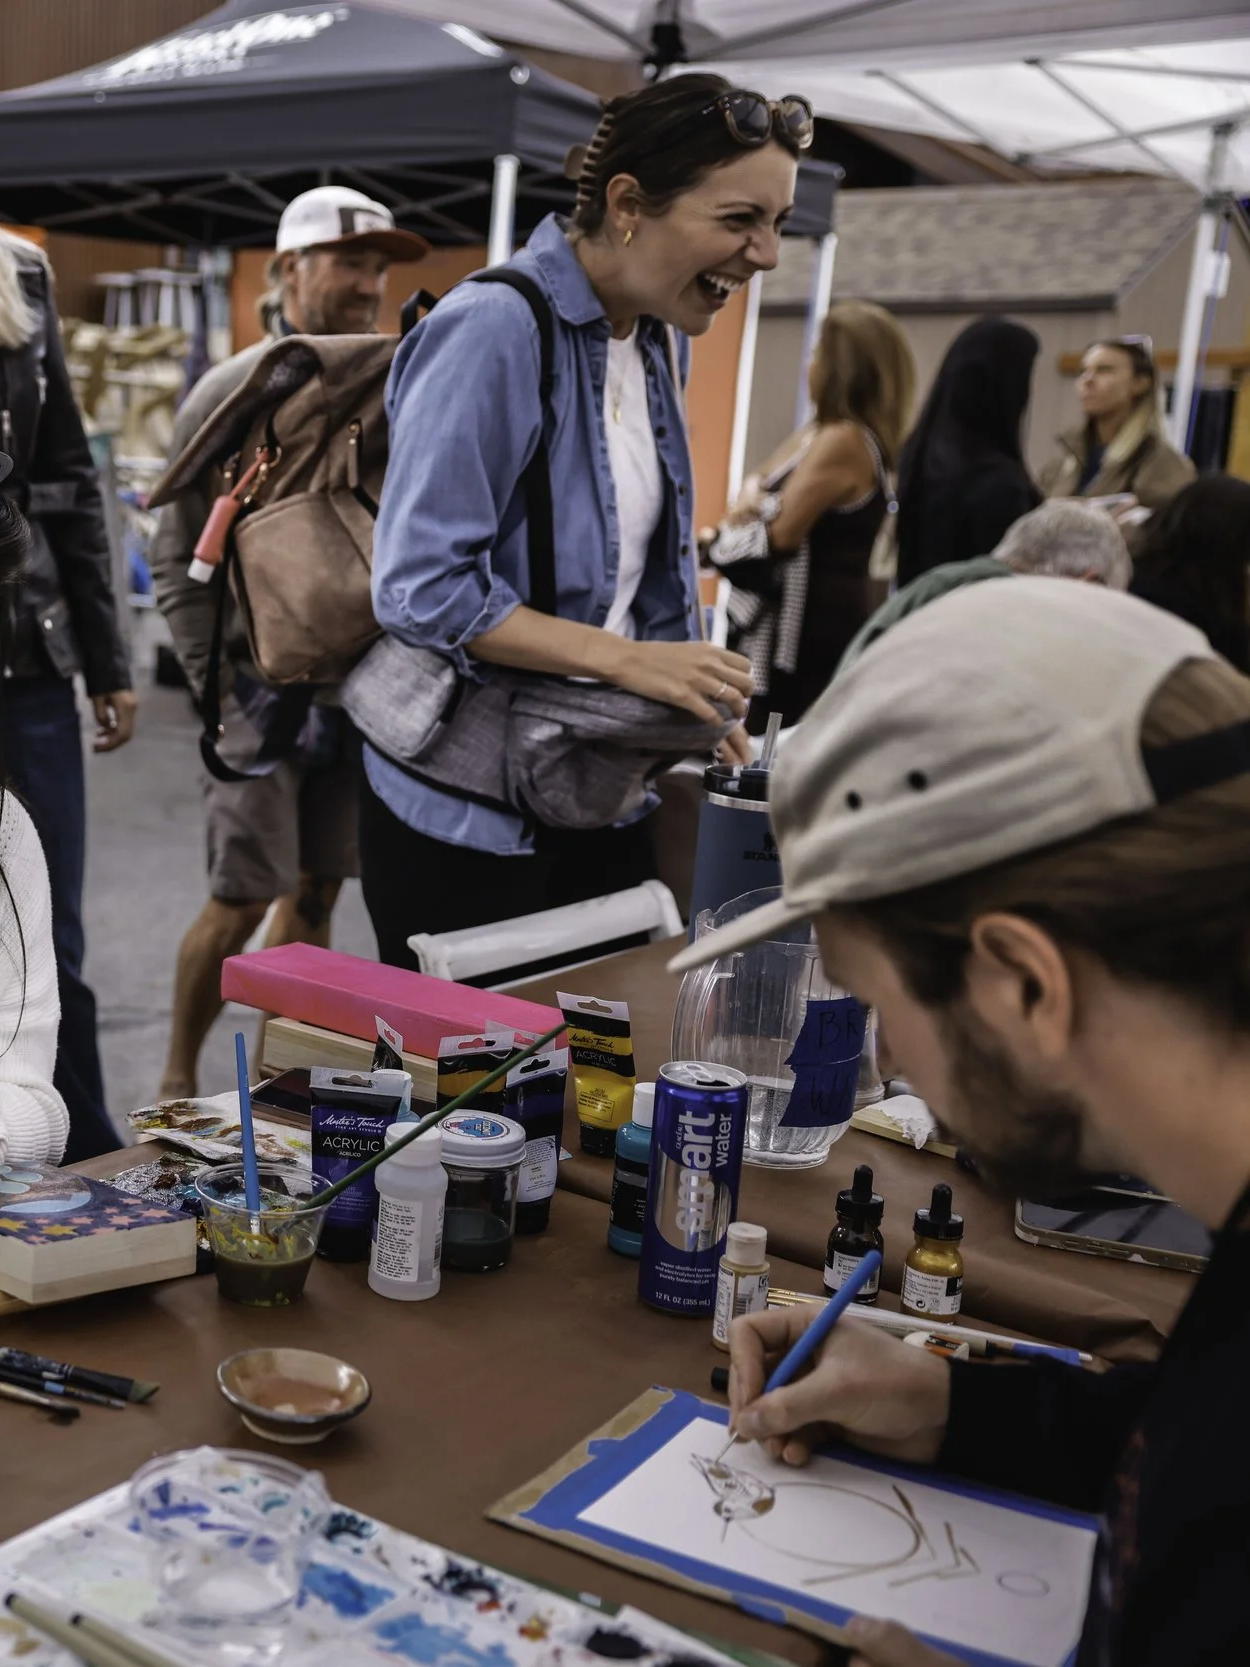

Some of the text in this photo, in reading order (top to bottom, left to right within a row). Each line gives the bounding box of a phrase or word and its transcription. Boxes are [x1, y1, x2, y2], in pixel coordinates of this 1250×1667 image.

[576, 1050, 617, 1067] ACRYLIC
[319, 1114, 386, 1129] Master's Touch
[322, 1136, 380, 1152] ACRYLIC
[675, 1111, 716, 1232] smart
[655, 1291, 663, 1300] 12
[663, 1294, 671, 1303] FL
[672, 1296, 682, 1304] OZ
[683, 1298, 698, 1307] (355
